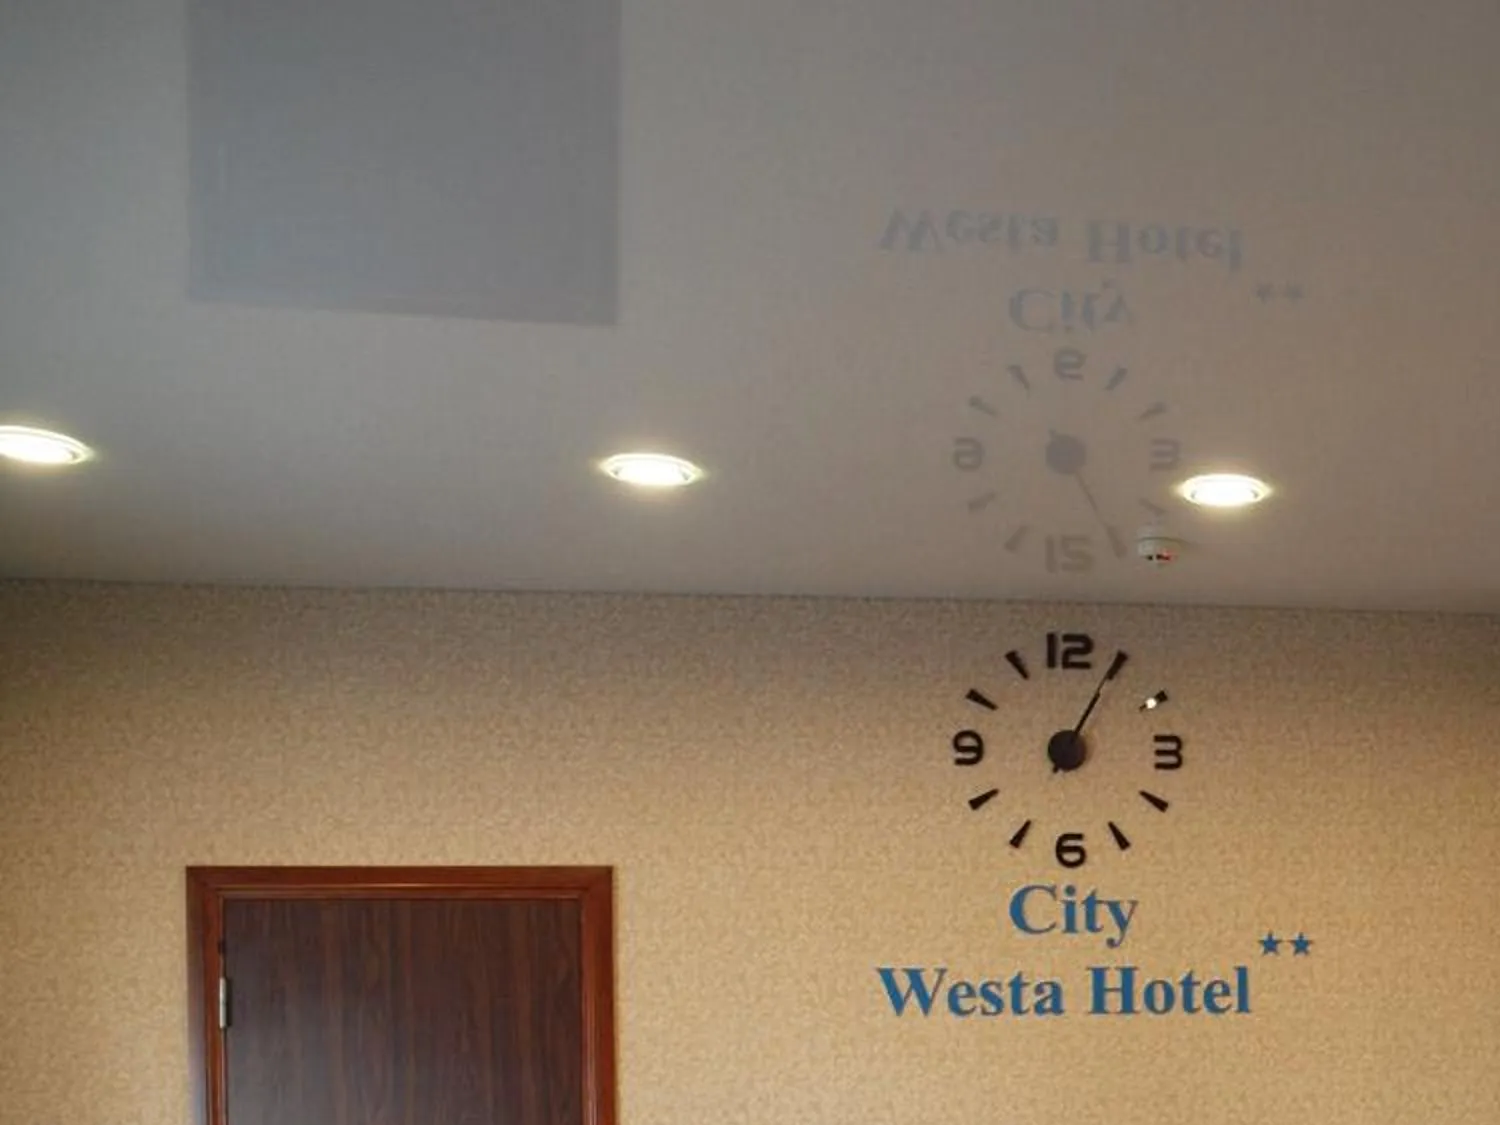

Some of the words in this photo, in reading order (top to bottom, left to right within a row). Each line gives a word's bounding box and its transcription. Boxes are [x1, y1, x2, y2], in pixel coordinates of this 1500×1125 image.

[1046, 632, 1094, 670] 12
[952, 729, 985, 766] 9
[1153, 734, 1185, 771] 3
[1055, 832, 1086, 869] 6
[1008, 883, 1140, 949] City
[876, 965, 1066, 1017] Westa
[1086, 964, 1252, 1015] Hotel
